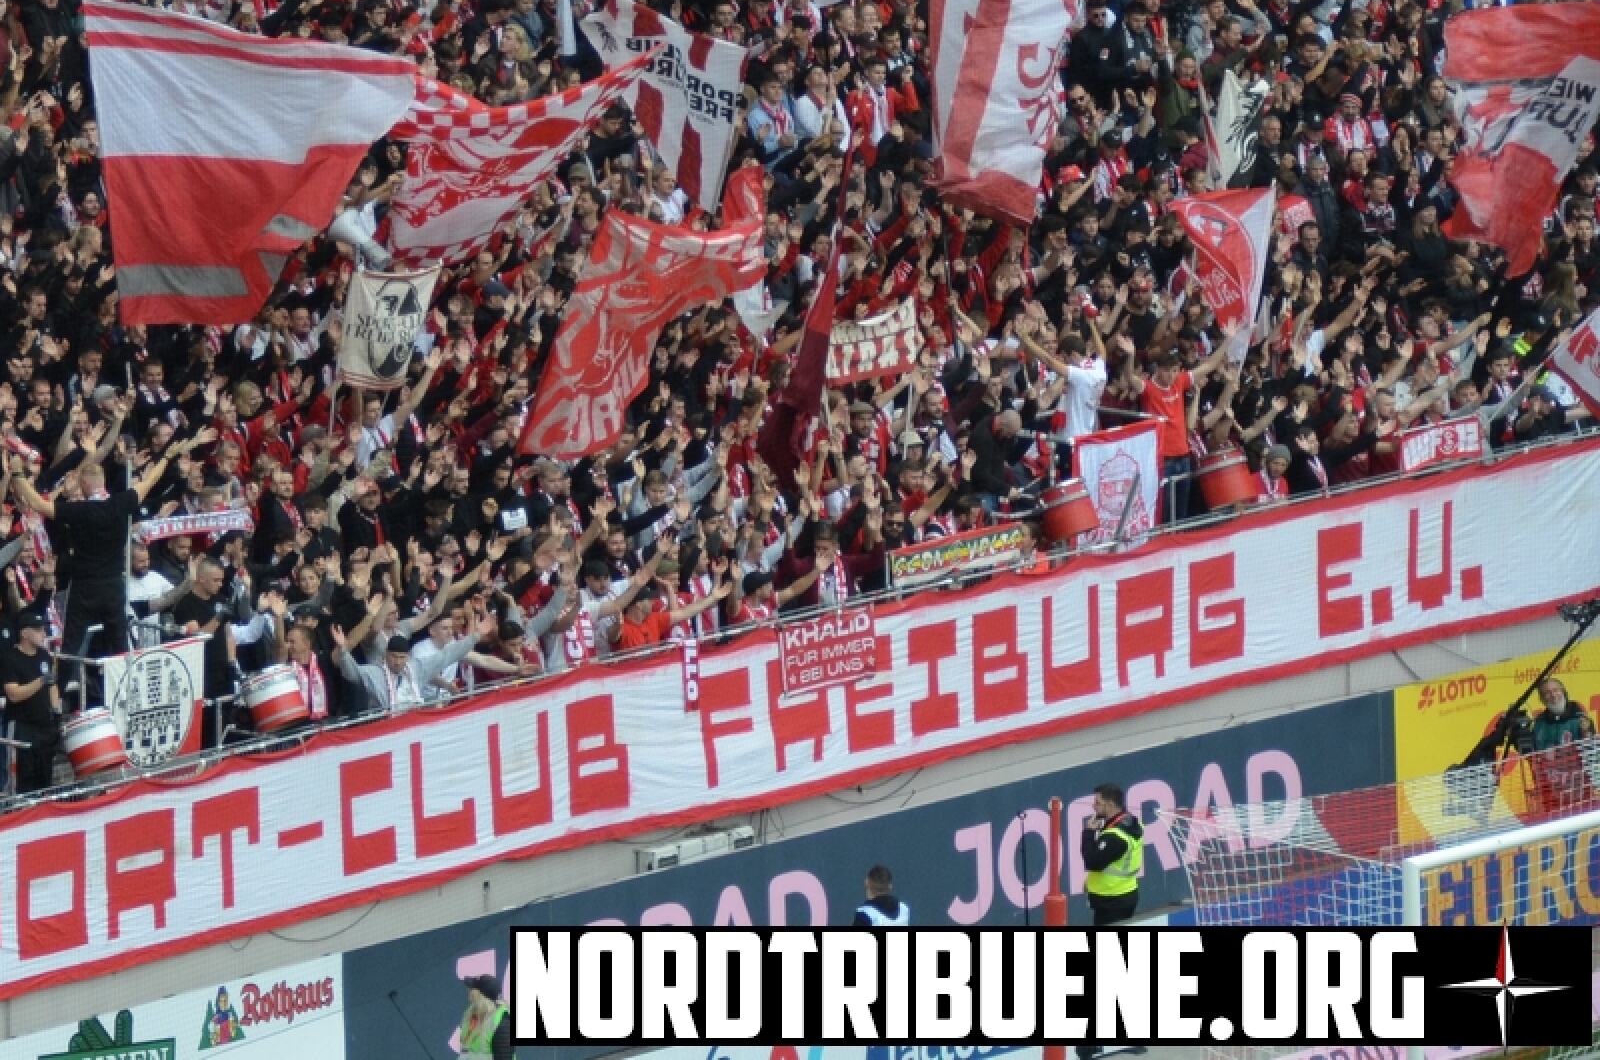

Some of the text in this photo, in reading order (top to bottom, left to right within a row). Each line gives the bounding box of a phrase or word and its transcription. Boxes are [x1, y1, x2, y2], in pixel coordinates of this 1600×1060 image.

[785, 613, 871, 651] KHALID
[822, 638, 875, 658] IMMER
[700, 551, 1245, 788] FREIBURG
[800, 657, 865, 683] BEI UNS
[1437, 673, 1488, 704] LOTTO
[240, 976, 335, 1026] Rothaus
